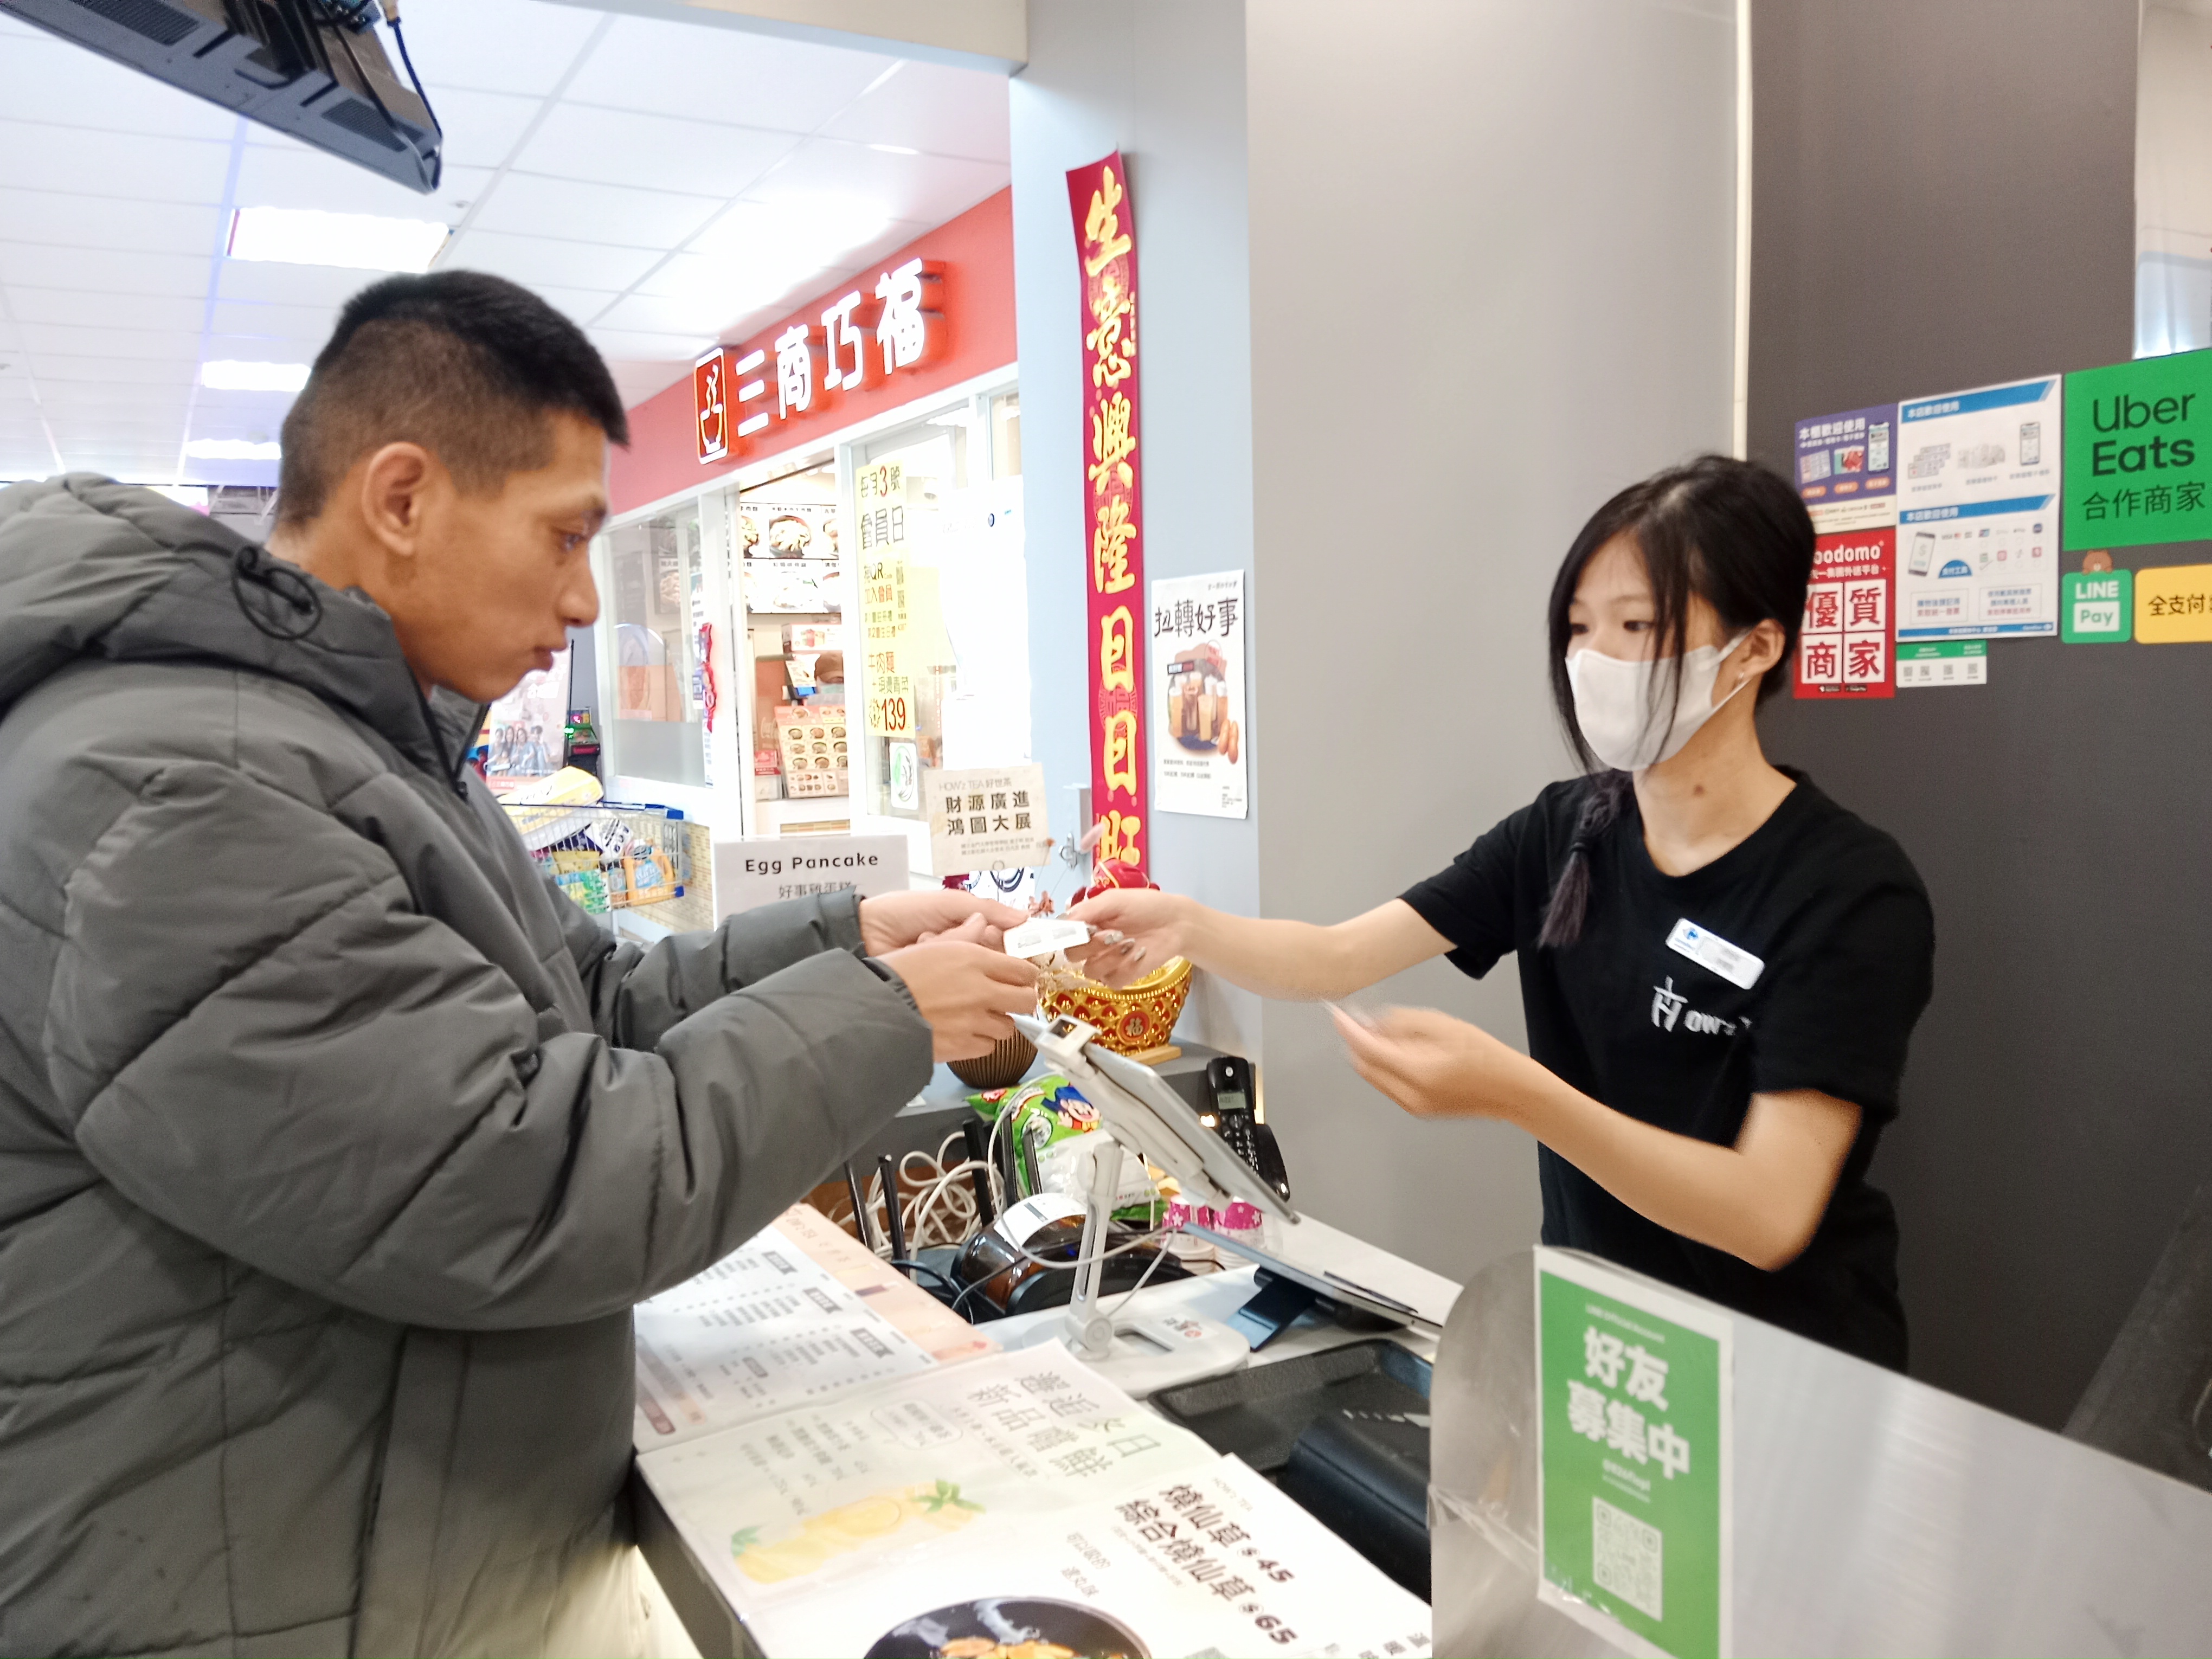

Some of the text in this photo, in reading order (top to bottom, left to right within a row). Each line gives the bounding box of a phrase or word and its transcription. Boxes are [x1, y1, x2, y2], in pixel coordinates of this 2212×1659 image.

[736, 258, 924, 437] 三商巧福
[2093, 393, 2196, 433] Uber
[2092, 435, 2196, 477] Eats
[2083, 481, 2206, 521] 合作商家
[860, 505, 904, 550] 會員日
[1814, 543, 1881, 565] oodomo
[1806, 587, 1882, 629] 優質
[2075, 581, 2119, 600] LINE
[2148, 594, 2212, 616] 全支付
[1154, 597, 1238, 638] 扭轉好事
[2080, 609, 2114, 626] Pay
[1806, 640, 1881, 679] 商家
[882, 697, 906, 731] 139
[946, 790, 1030, 813] 財源廣進
[968, 779, 984, 789] TEA
[947, 813, 1032, 835] 鴻圖大展
[745, 853, 879, 874] Egg Pancake
[1125, 1017, 1144, 1037] 福
[1584, 1325, 1669, 1411] 好友
[1567, 1379, 1690, 1481] 募集中
[1159, 1483, 1251, 1548] 燒仙草
[1114, 1499, 1256, 1602] 綜合燒仙草
